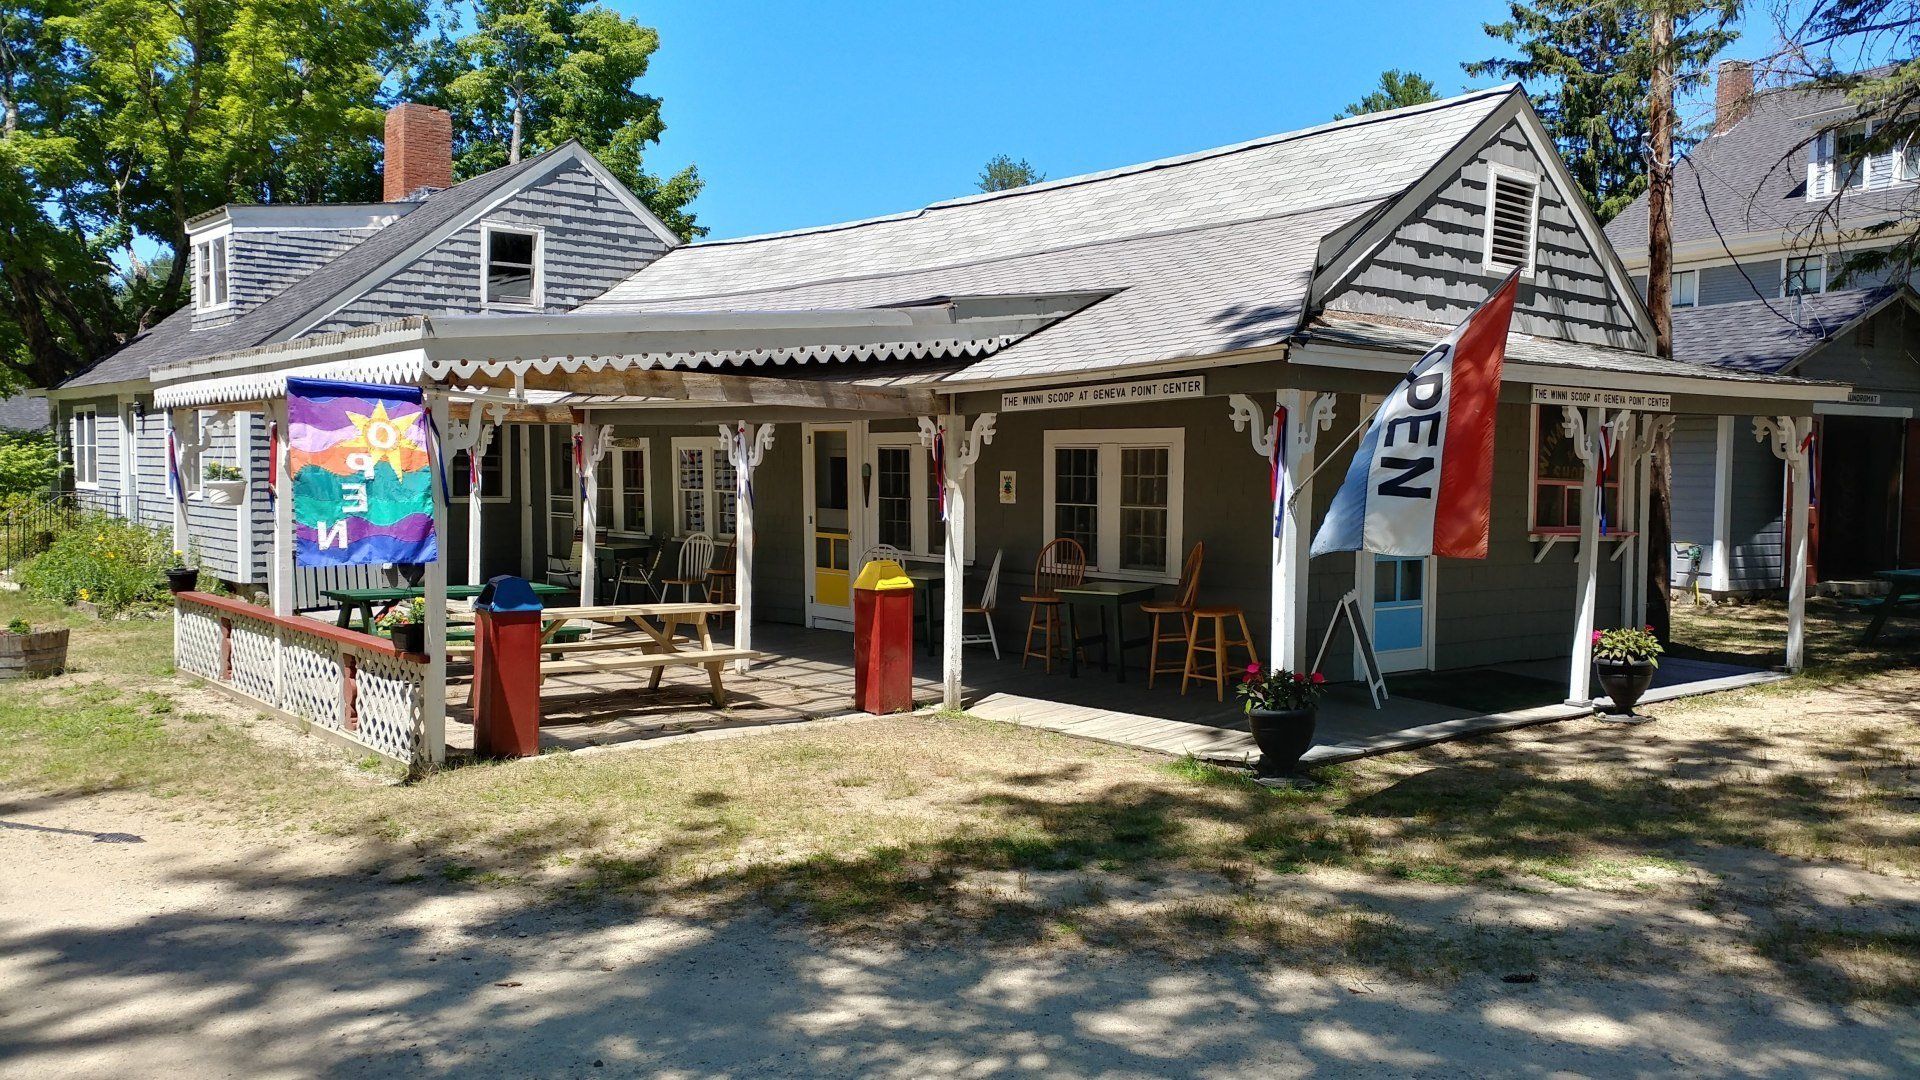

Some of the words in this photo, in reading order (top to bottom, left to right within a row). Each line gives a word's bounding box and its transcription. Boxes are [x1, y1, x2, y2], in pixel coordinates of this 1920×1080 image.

[1004, 396, 1018, 407] THE
[1022, 394, 1044, 406] WINNI
[1047, 391, 1075, 403] SCOOP
[1079, 390, 1089, 401] AT
[1093, 387, 1126, 400] GENEVA
[1131, 384, 1157, 396] POINT
[1163, 380, 1201, 394] CENTER
[1535, 388, 1547, 399] THE
[1551, 389, 1568, 400] WINNI
[1571, 391, 1590, 402] SCOOP
[1594, 393, 1601, 402] AT
[1603, 394, 1626, 404] GENEVA
[1628, 395, 1646, 406] POINT
[1647, 397, 1670, 407] CENTER
[1377, 343, 1452, 499] OPEN
